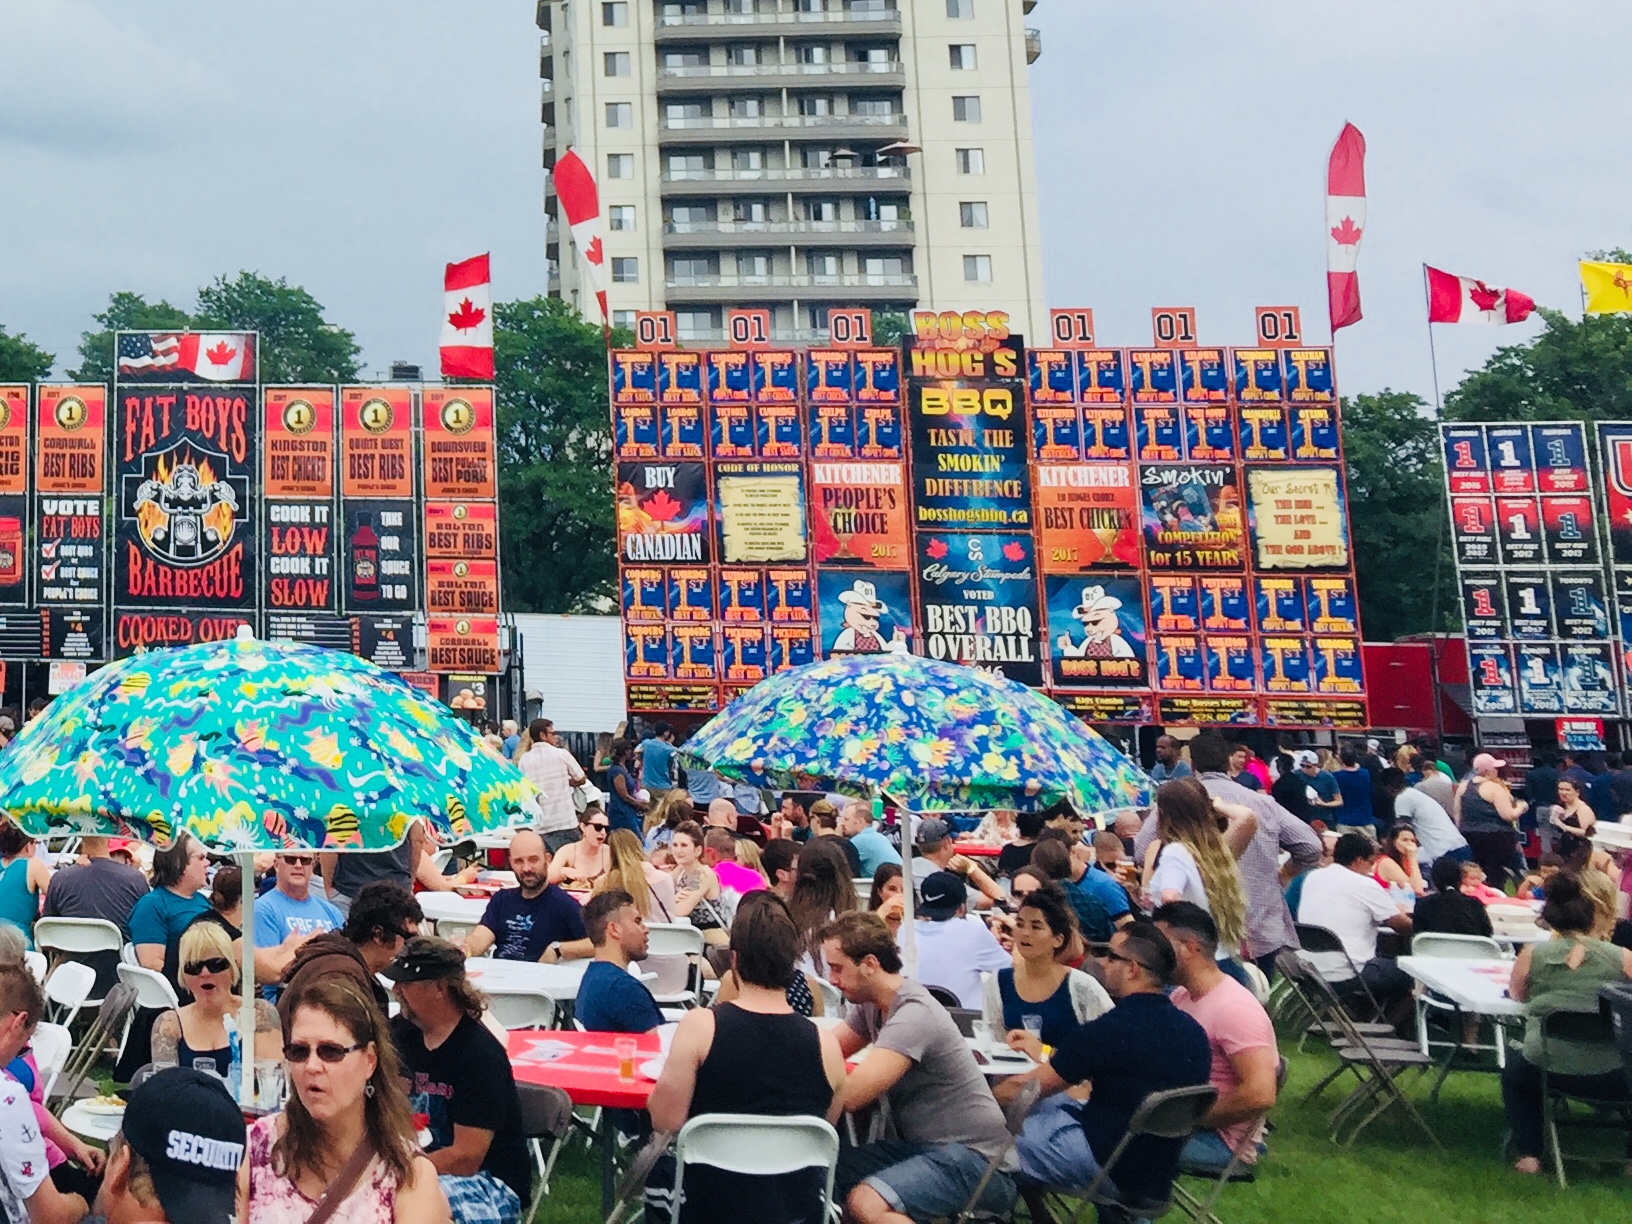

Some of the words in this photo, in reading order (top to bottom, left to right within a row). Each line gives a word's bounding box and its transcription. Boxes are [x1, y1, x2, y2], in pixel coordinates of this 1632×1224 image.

[639, 316, 673, 344] 01
[732, 315, 766, 343] 01
[833, 315, 868, 343] 01
[914, 310, 1010, 340] BOSS
[1055, 313, 1092, 342] 01
[1157, 313, 1194, 342] 01
[1261, 312, 1298, 340] 01
[921, 387, 1013, 421] BBQ
[124, 395, 176, 462] FAT
[185, 395, 246, 464] BOYS
[928, 429, 976, 447] TASTE
[982, 429, 1014, 447] THE
[44, 438, 96, 449] CORNWALL
[271, 440, 327, 452] KINGSTON
[431, 441, 487, 453] DOWNSVIEW
[43, 453, 67, 477] BEST
[69, 453, 96, 479] RIBS
[349, 454, 376, 479] BEST
[379, 454, 405, 481] RIBS
[813, 463, 901, 484] KITCHENER
[938, 454, 1005, 472] SMOKIN'
[644, 466, 676, 488] BUY
[1039, 466, 1130, 487] KITCHENER
[1142, 466, 1230, 487] Smokin'
[821, 487, 896, 509] PEOPLE'S
[925, 478, 1022, 498] DIFFERENCE
[43, 500, 99, 515] VOTE
[270, 505, 311, 523] COOK
[314, 506, 329, 522] IT
[1044, 507, 1074, 529] BEST
[1079, 507, 1132, 529] CHICKEN
[42, 516, 65, 538] FAT
[71, 517, 100, 538] BOYS
[380, 512, 402, 526] TAKE
[833, 512, 888, 534] CHOICE
[271, 526, 328, 555] LOW
[429, 532, 458, 549] BEST
[463, 533, 492, 550] RIBS
[626, 533, 702, 560] CANADIAN
[1158, 531, 1237, 544] COMPETITION
[270, 557, 311, 574] COOK
[315, 557, 329, 574] IT
[1052, 547, 1079, 562] 2017
[128, 540, 243, 598] BARBECUE
[381, 561, 410, 575] SAUCE
[923, 563, 970, 585] Calgary
[971, 565, 1032, 584] Stampede
[270, 579, 329, 606] SLOW
[381, 585, 392, 599] TO
[394, 585, 407, 599] GO
[431, 592, 457, 607] BEST
[459, 592, 494, 608] SAUCE
[963, 590, 994, 600] VOTED
[119, 615, 192, 648] COOKED
[199, 618, 248, 642] OVE
[926, 605, 978, 634] BEST
[985, 606, 1033, 638] BBQ
[431, 648, 459, 664] BEST
[459, 649, 495, 665] SAUCE
[929, 634, 1034, 663] OVERALL
